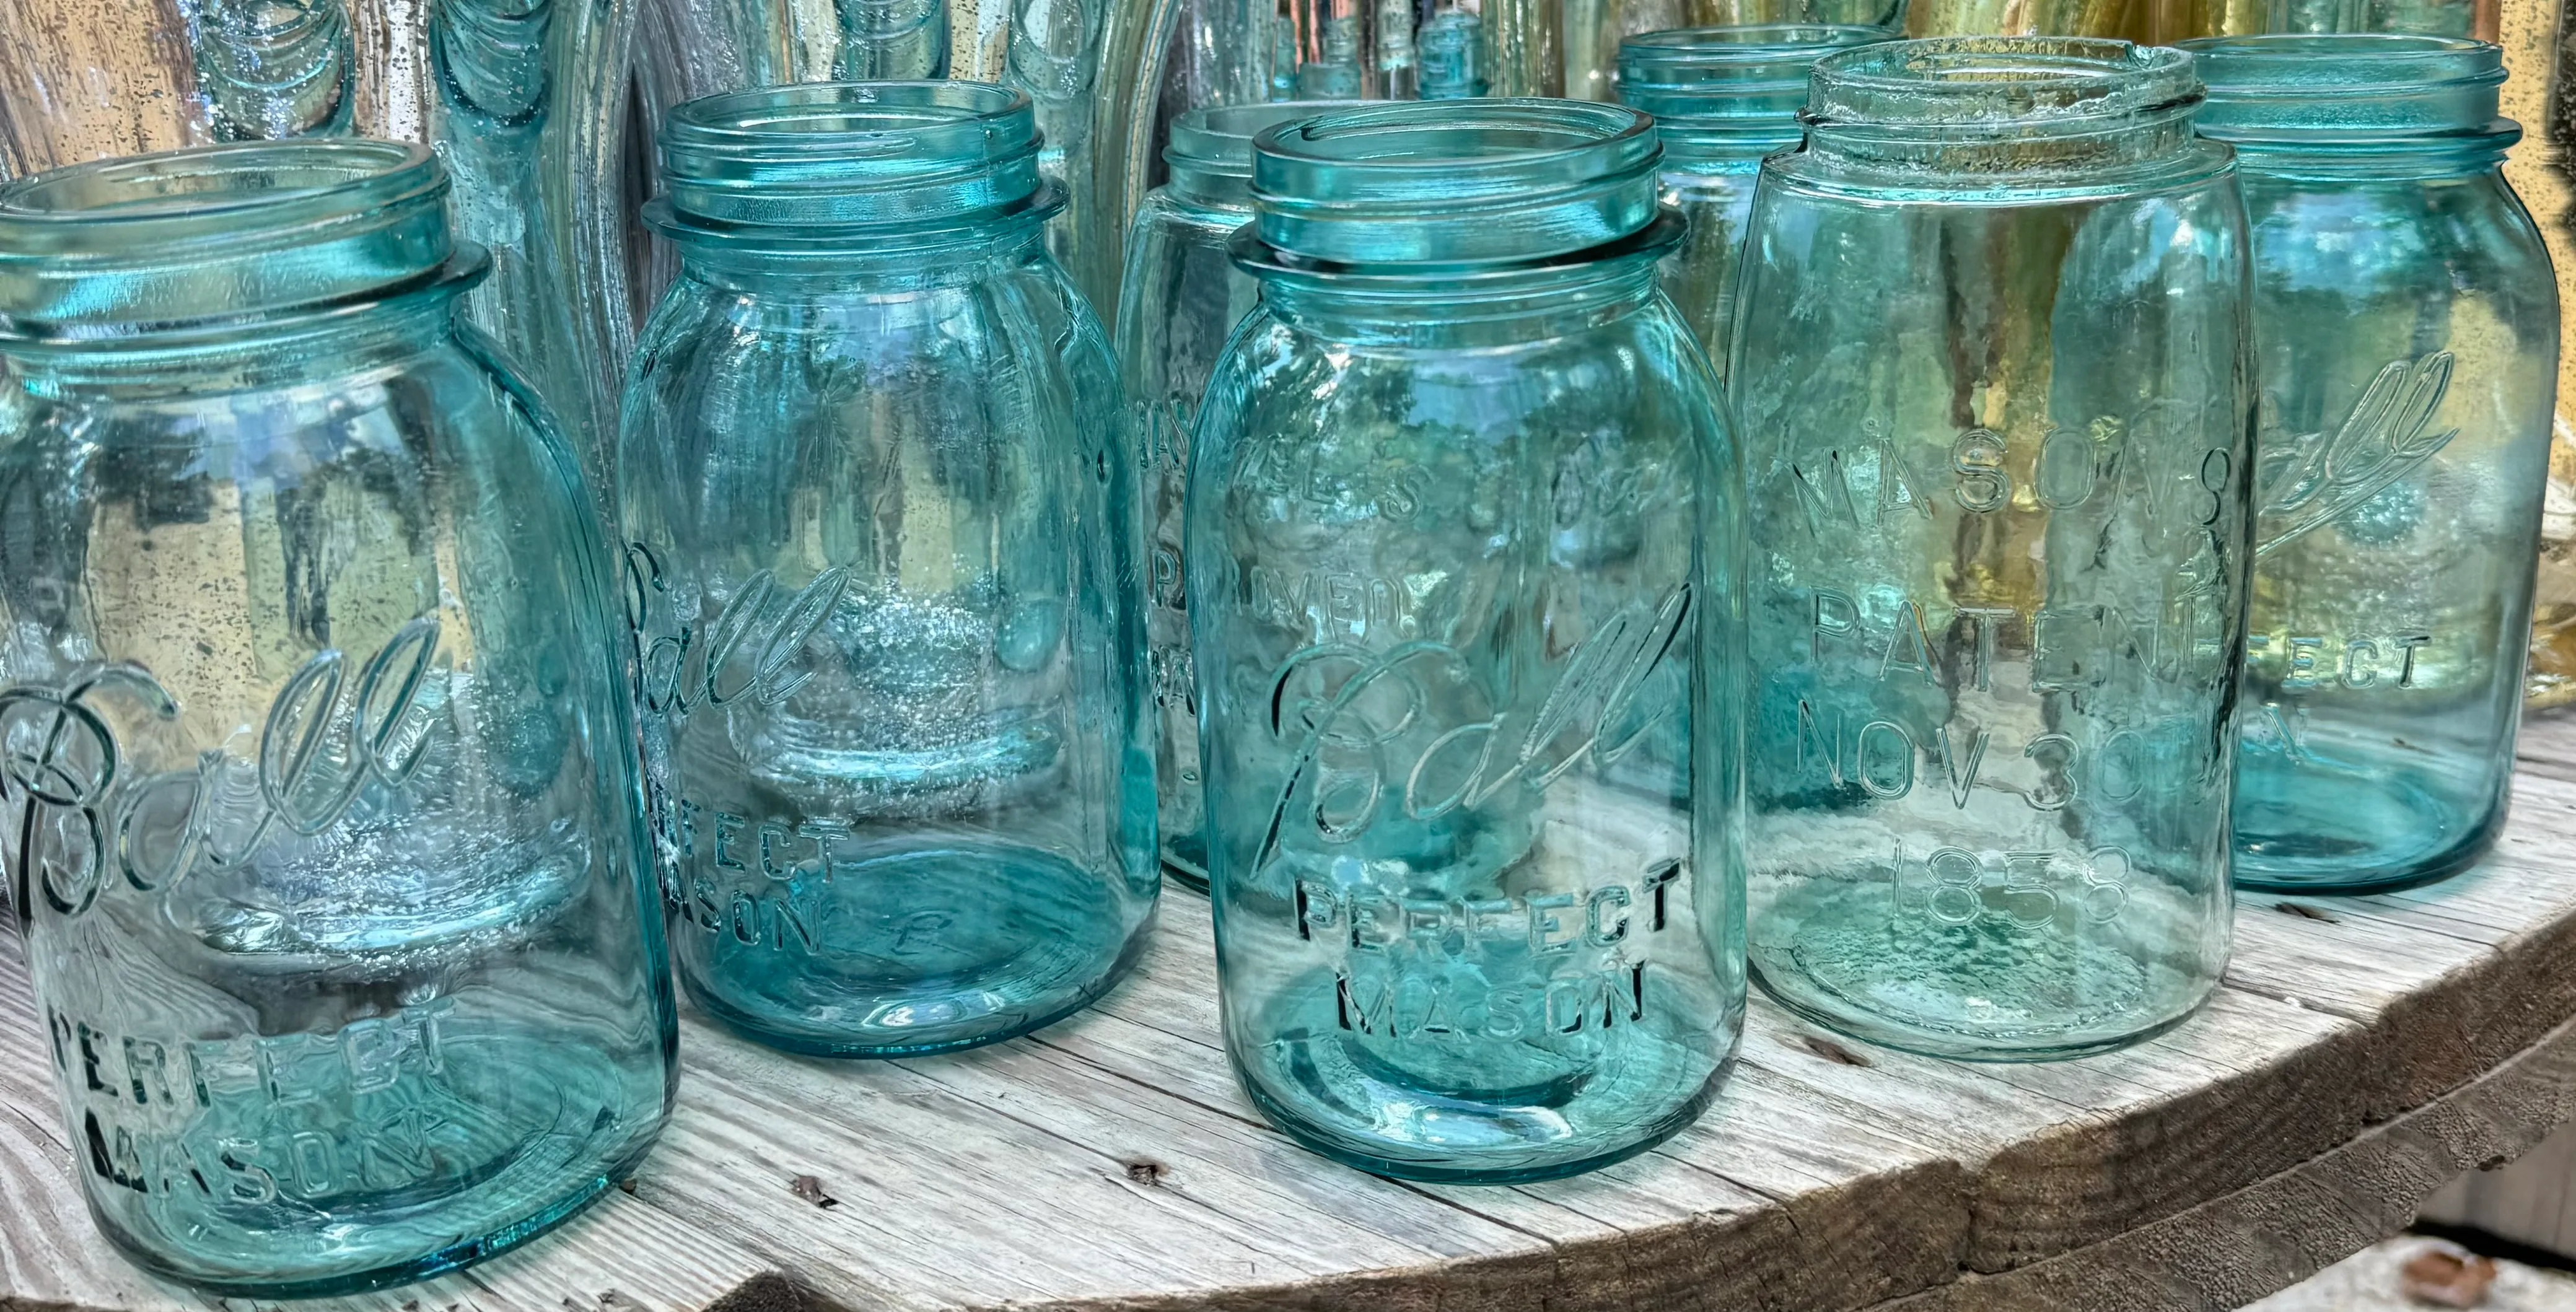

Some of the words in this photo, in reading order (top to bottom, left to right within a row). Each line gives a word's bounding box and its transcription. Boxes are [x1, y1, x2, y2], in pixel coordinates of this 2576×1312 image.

[1809, 581, 2218, 694] PATENT
[0, 613, 441, 935] Ball
[1249, 581, 1696, 880] Ball
[1795, 698, 1991, 811] NOV
[1291, 856, 1682, 955] PERFECT
[1891, 836, 2132, 932] 1858
[46, 995, 457, 1109] PERFECT
[1333, 958, 1650, 1042] MASON
